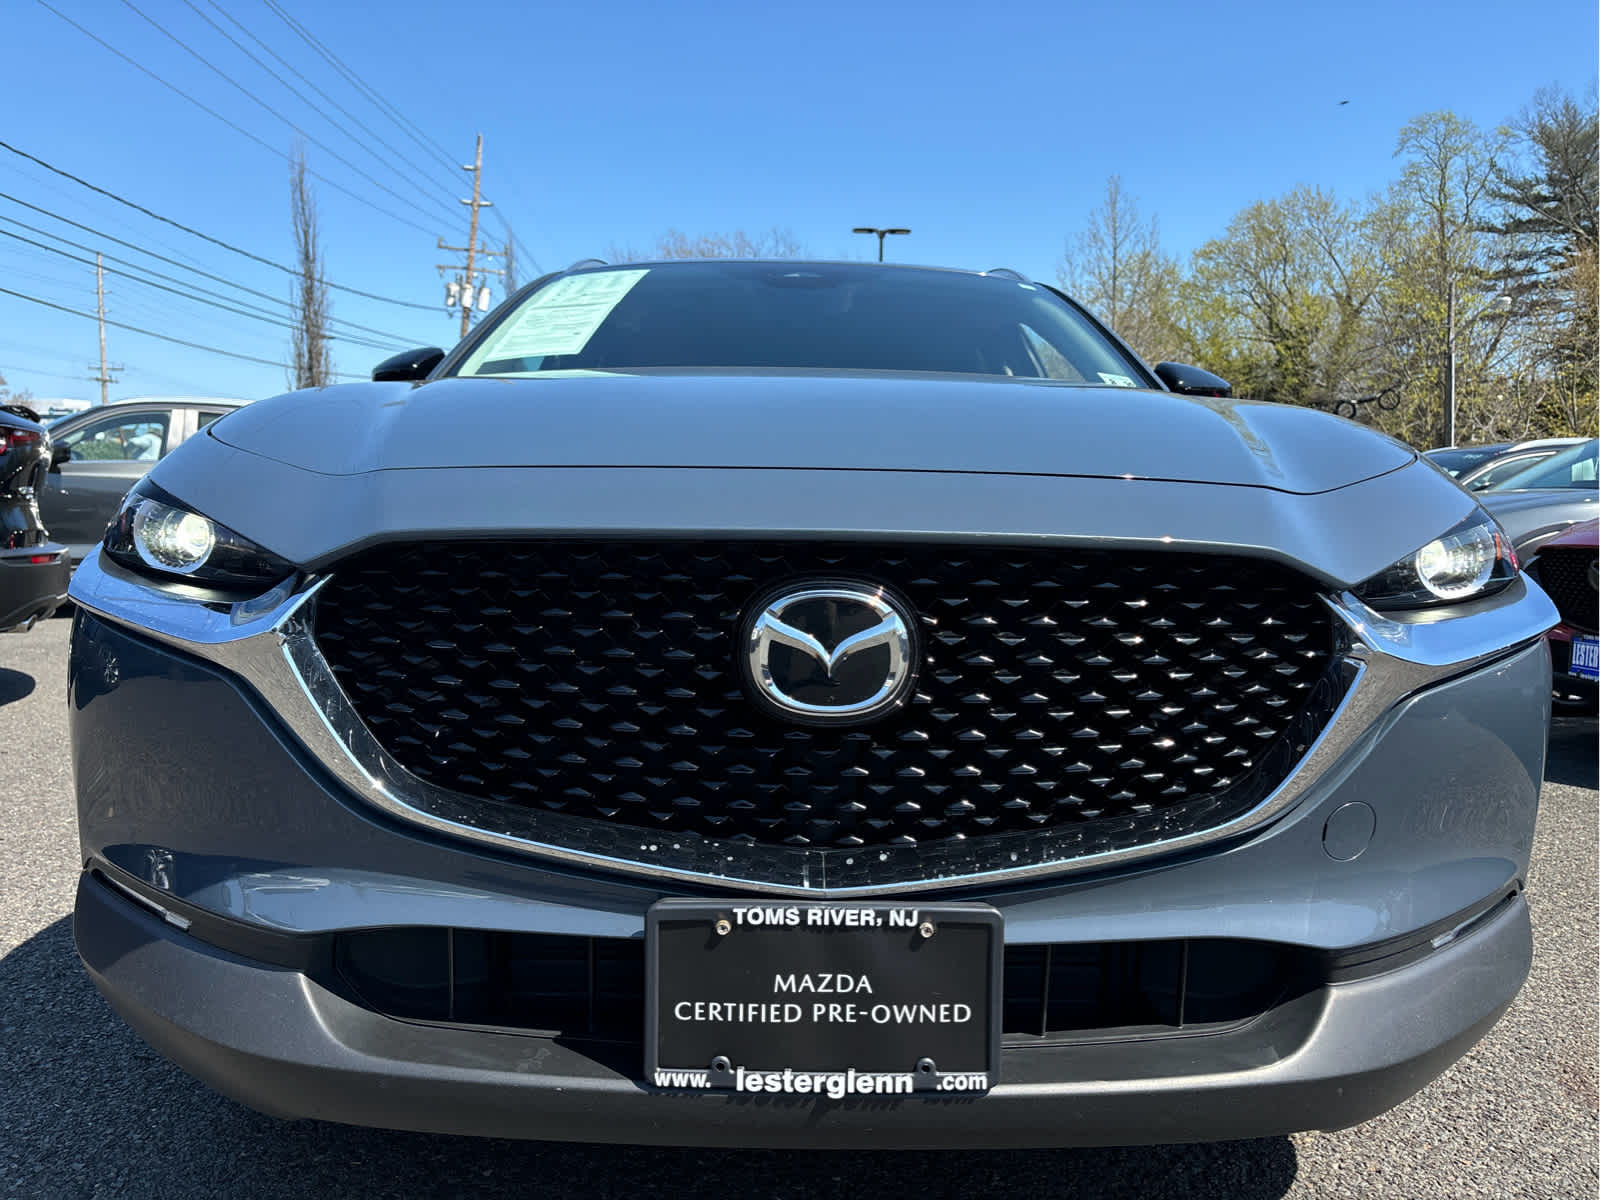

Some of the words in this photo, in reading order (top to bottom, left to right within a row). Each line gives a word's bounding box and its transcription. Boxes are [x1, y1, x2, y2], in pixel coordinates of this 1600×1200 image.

[732, 907, 801, 926] TOMS
[806, 908, 883, 928] RIVER,
[888, 908, 919, 928] NJ
[773, 973, 873, 994] MAZDA
[674, 1001, 802, 1023] CERTIFIED
[812, 1003, 972, 1024] PRE-OWNED
[654, 1070, 712, 1089] www.
[736, 1065, 914, 1099] lesterglenn
[935, 1072, 988, 1091] .com
